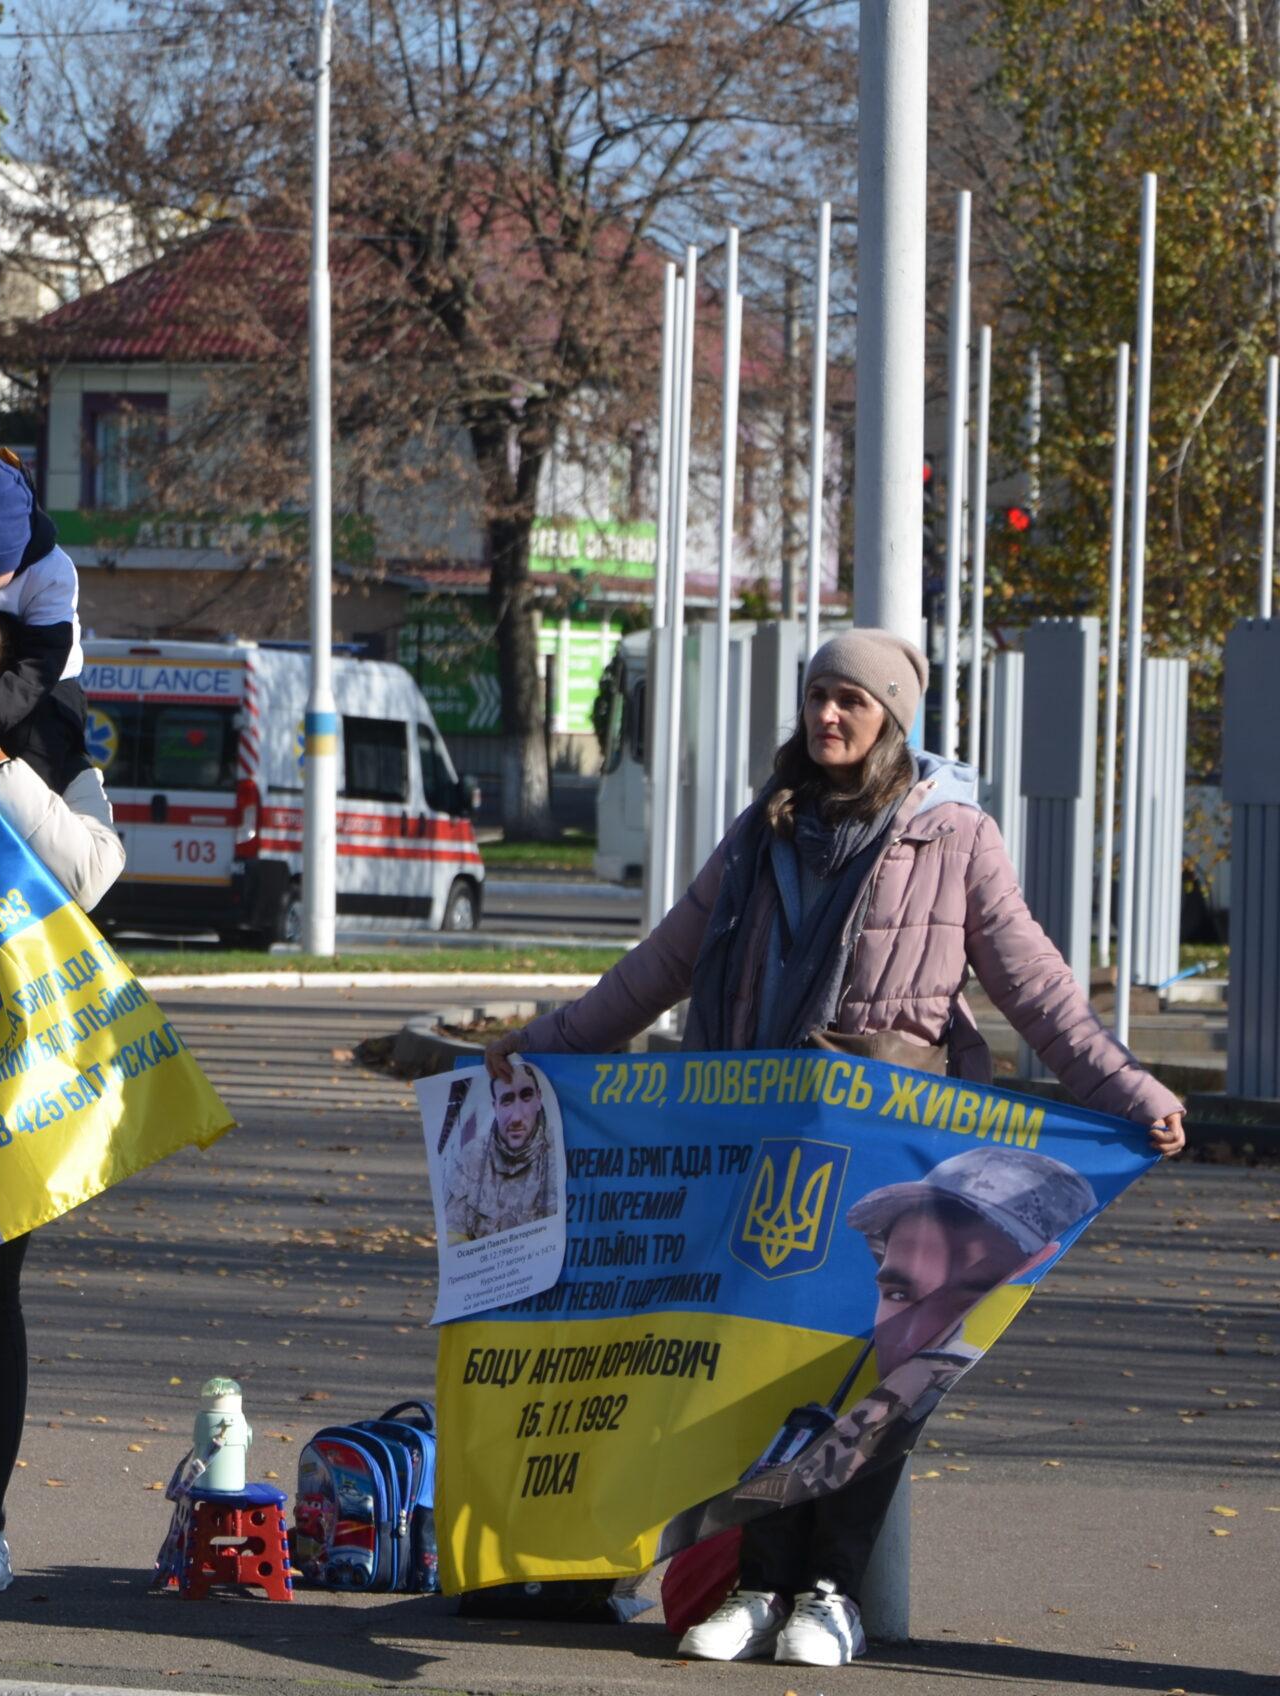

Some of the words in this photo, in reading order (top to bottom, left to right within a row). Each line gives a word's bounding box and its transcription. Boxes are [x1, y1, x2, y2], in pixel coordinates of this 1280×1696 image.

[76, 666, 232, 693] MBULANCE
[174, 841, 217, 863] 103
[12, 948, 105, 1016] БРИГАДА
[35, 977, 150, 1062] БАТАЛЬЙОН
[16, 1090, 65, 1135] 425
[59, 1062, 110, 1112] БАТ
[589, 1061, 668, 1109] ТАТО,
[676, 1057, 874, 1112] ПОВЕРНИСЬ
[879, 1072, 1046, 1149] ЖИВИМ
[566, 1145, 625, 1179] КРЕМА
[627, 1144, 712, 1180] БРИГАДА
[718, 1144, 754, 1176] ТРО
[598, 1186, 688, 1223] ОКРЕМИЙ
[565, 1232, 648, 1269] ТАЛЬЙОН
[652, 1234, 685, 1264] ТРО
[462, 1348, 531, 1388] БОЦУ
[528, 1345, 599, 1385] АНТОН
[596, 1333, 721, 1380] ЮРІЙОВИЧ
[516, 1394, 629, 1439] 15.11.1992
[521, 1452, 580, 1498] ТОХА
